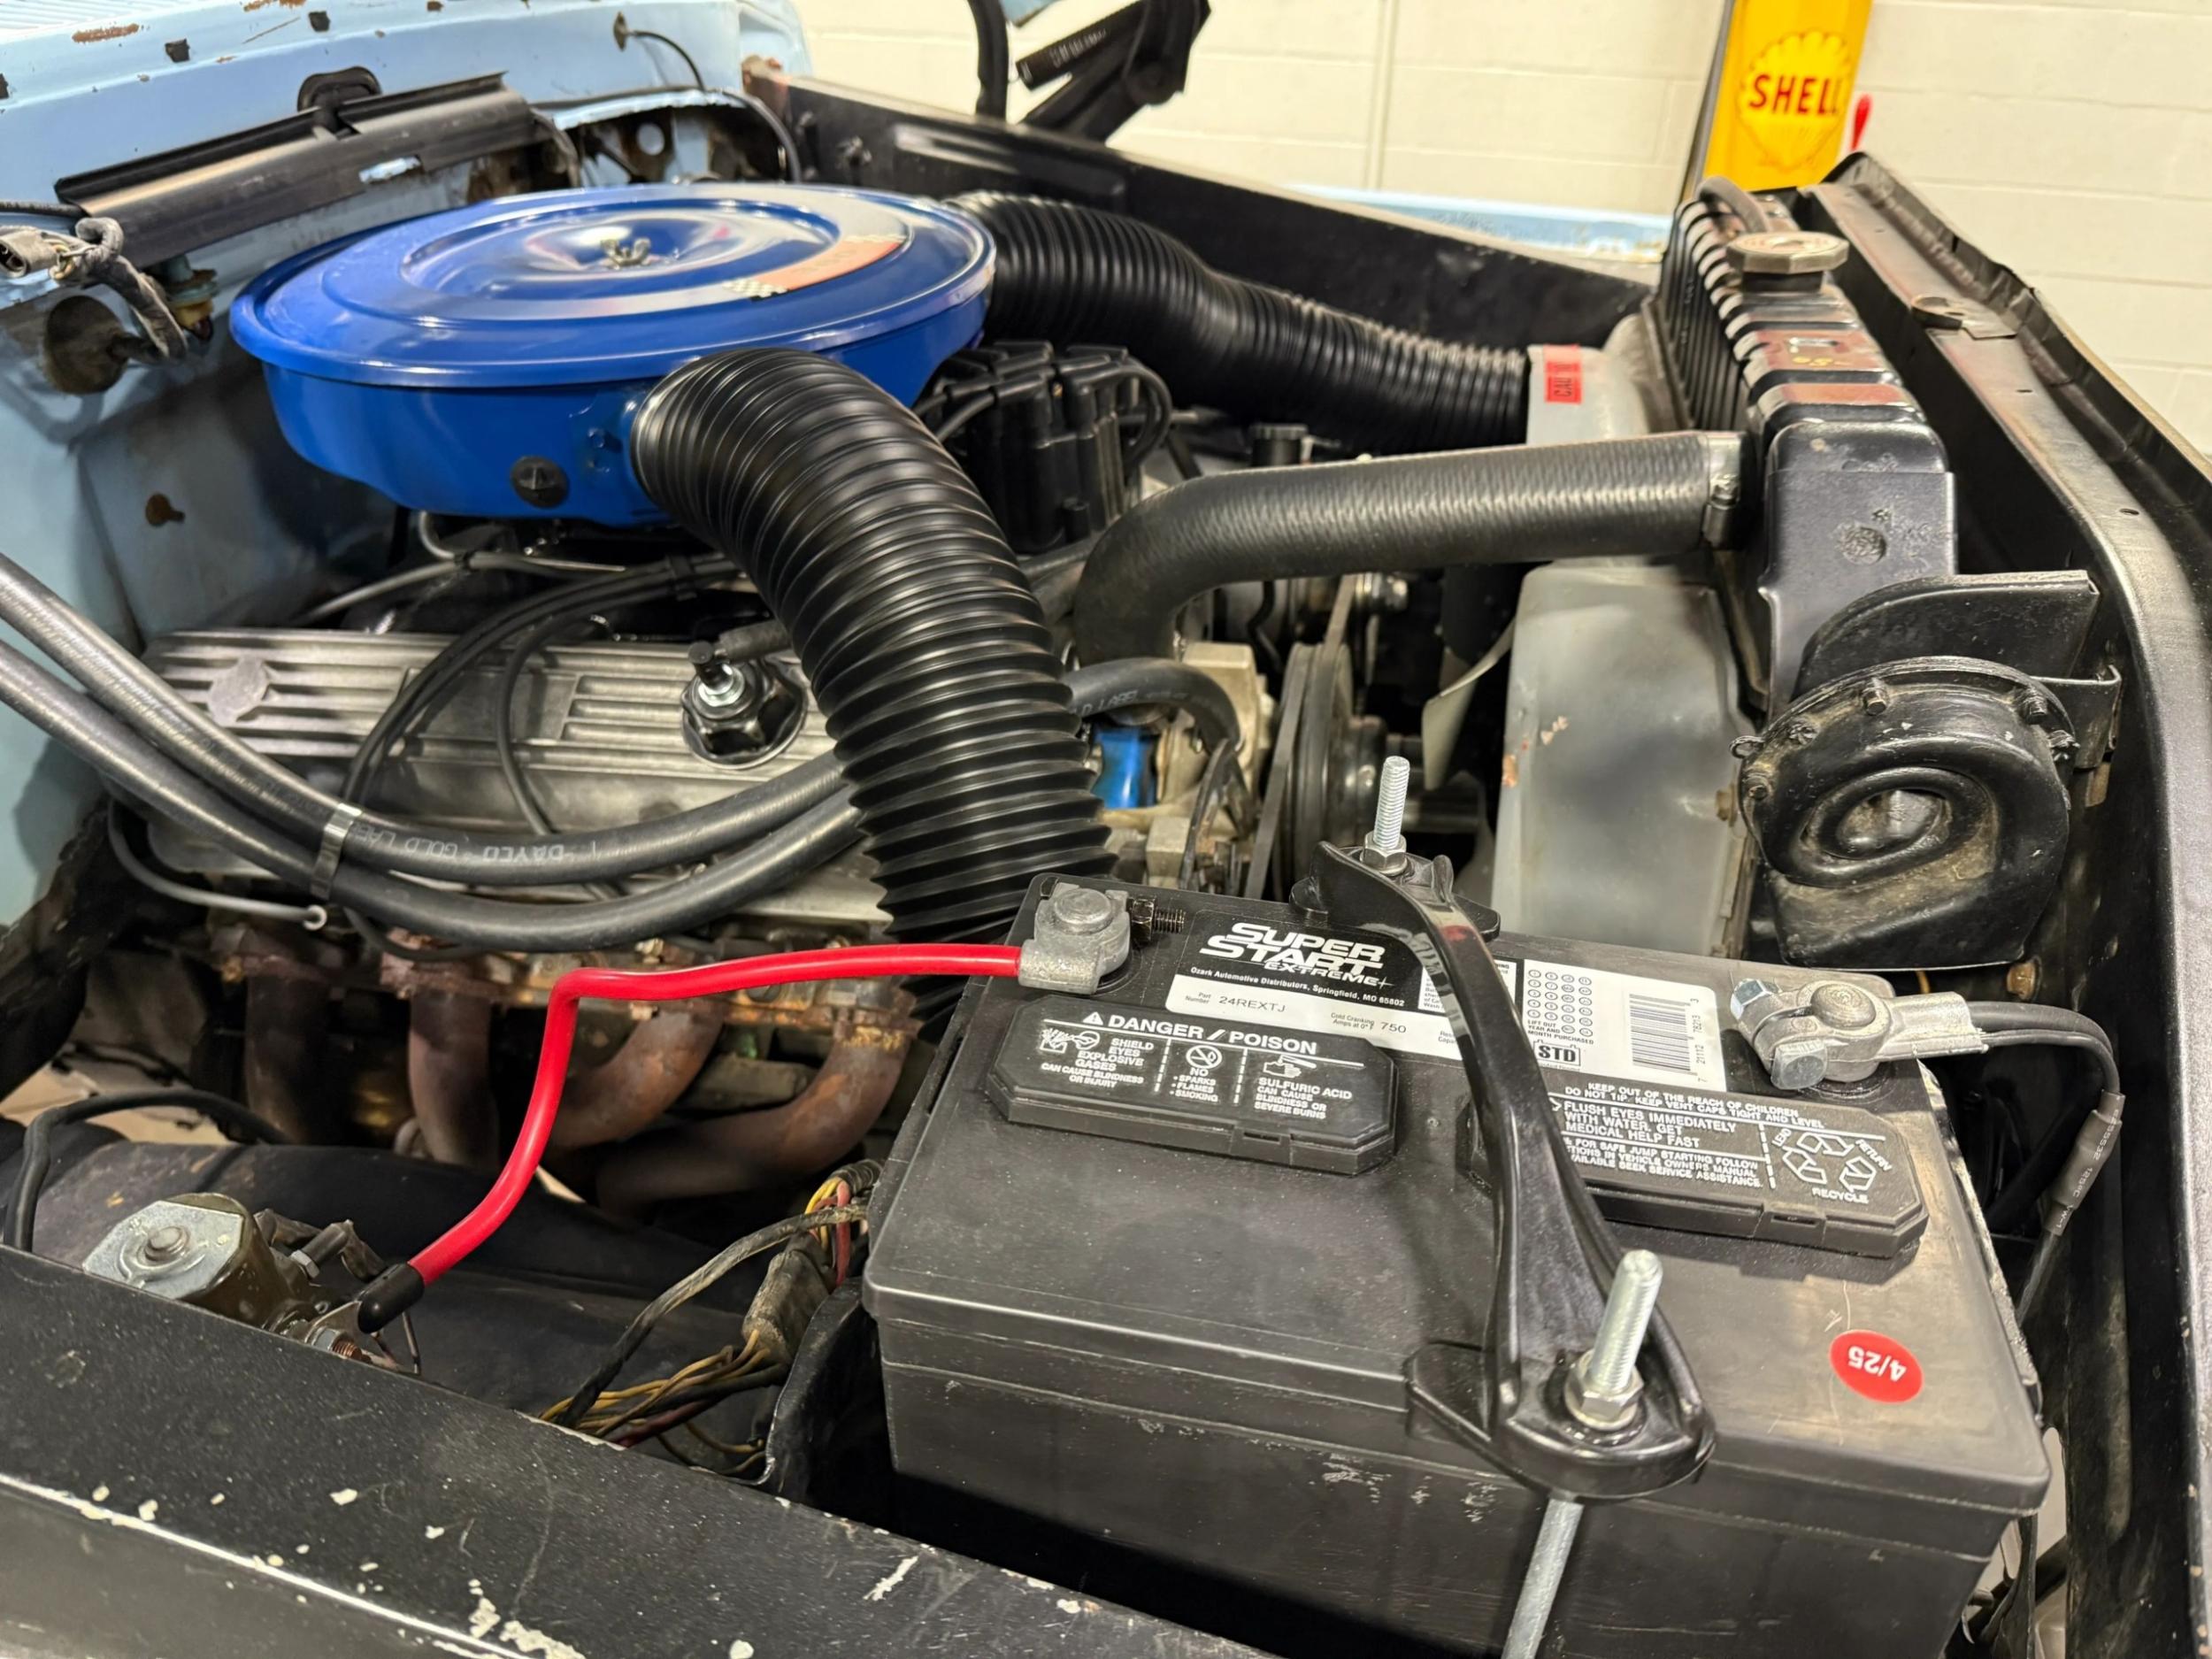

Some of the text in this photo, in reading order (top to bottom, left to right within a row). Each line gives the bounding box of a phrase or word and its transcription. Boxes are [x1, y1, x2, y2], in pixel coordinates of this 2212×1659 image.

[1748, 73, 1839, 115] SHELL
[404, 837, 458, 858] GOLD
[482, 843, 565, 863] DAYCO
[1231, 922, 1386, 963] SUPER
[1199, 934, 1384, 976] START
[1190, 966, 1213, 977] Ozark
[1214, 970, 1259, 984] Automotive
[1261, 977, 1310, 992] Distributors,
[1312, 984, 1360, 1000] Springfield,
[1363, 994, 1378, 1003] MO
[1184, 995, 1210, 1004] Number
[1218, 995, 1286, 1013] 24REXTJ
[1333, 1018, 1353, 1027] Amps
[1346, 1015, 1375, 1025] Cranking
[1380, 1021, 1408, 1033] 750
[1108, 1014, 1317, 1056] DANGER / POISON
[1554, 1033, 1594, 1045] PURCHASED
[1108, 1046, 1141, 1057] EYES
[1110, 1038, 1155, 1051] SHIELD
[1077, 1050, 1145, 1067] EXPLOSIVE
[1538, 1045, 1576, 1063] STD
[1041, 1062, 1145, 1085] CAN CAUSE BLINDNESS
[1075, 1058, 1117, 1071] GASES
[1189, 1067, 1210, 1077] NO
[1069, 1074, 1118, 1088] OR INJURY
[1177, 1081, 1215, 1094] FLAMES
[1179, 1074, 1217, 1087] SPARKS
[1258, 1077, 1353, 1100] SULFURIC ACID
[1175, 1089, 1219, 1102] SMOKING
[1256, 1093, 1327, 1111] BLINDNESS OR
[1257, 1086, 1314, 1102] CAN CAUSE
[1588, 1082, 1800, 1118] KEEP OUT OF THE REACH OF CHILDREN
[1254, 1101, 1326, 1119] SEVERE BURNS
[1564, 1086, 1581, 1096] DO
[1584, 1090, 1607, 1100] NOT
[1634, 1096, 1663, 1107] KEEP
[1665, 1101, 1694, 1112] VENT
[1697, 1104, 1727, 1116] CAPS
[1729, 1108, 1763, 1120] TIGHT
[1765, 1114, 1789, 1124] AND
[1791, 1117, 1825, 1129] LEVEL
[1563, 1101, 1737, 1133] FLUSH EYES IMMEDIATELY
[1564, 1111, 1683, 1136] WITH WATER. GET
[1565, 1122, 1700, 1148] MEDICAL HELP FAST
[1575, 1138, 1597, 1148] FOR
[1599, 1141, 1626, 1154] SAFE
[1629, 1147, 1658, 1157] JUMP
[1660, 1150, 1714, 1165] STARTING
[1715, 1156, 1759, 1170] FOLLOW
[1855, 1139, 1893, 1171] RETURN
[1604, 1150, 1616, 1159] IN
[1617, 1152, 1662, 1166] VEHICLE
[1712, 1164, 1757, 1179] MANUAL
[1618, 1160, 1647, 1172] SEEK
[1648, 1165, 1694, 1179] SERVICE
[1811, 1187, 1870, 1204] RECYCLE
[1847, 1345, 1908, 1382] 4/25
